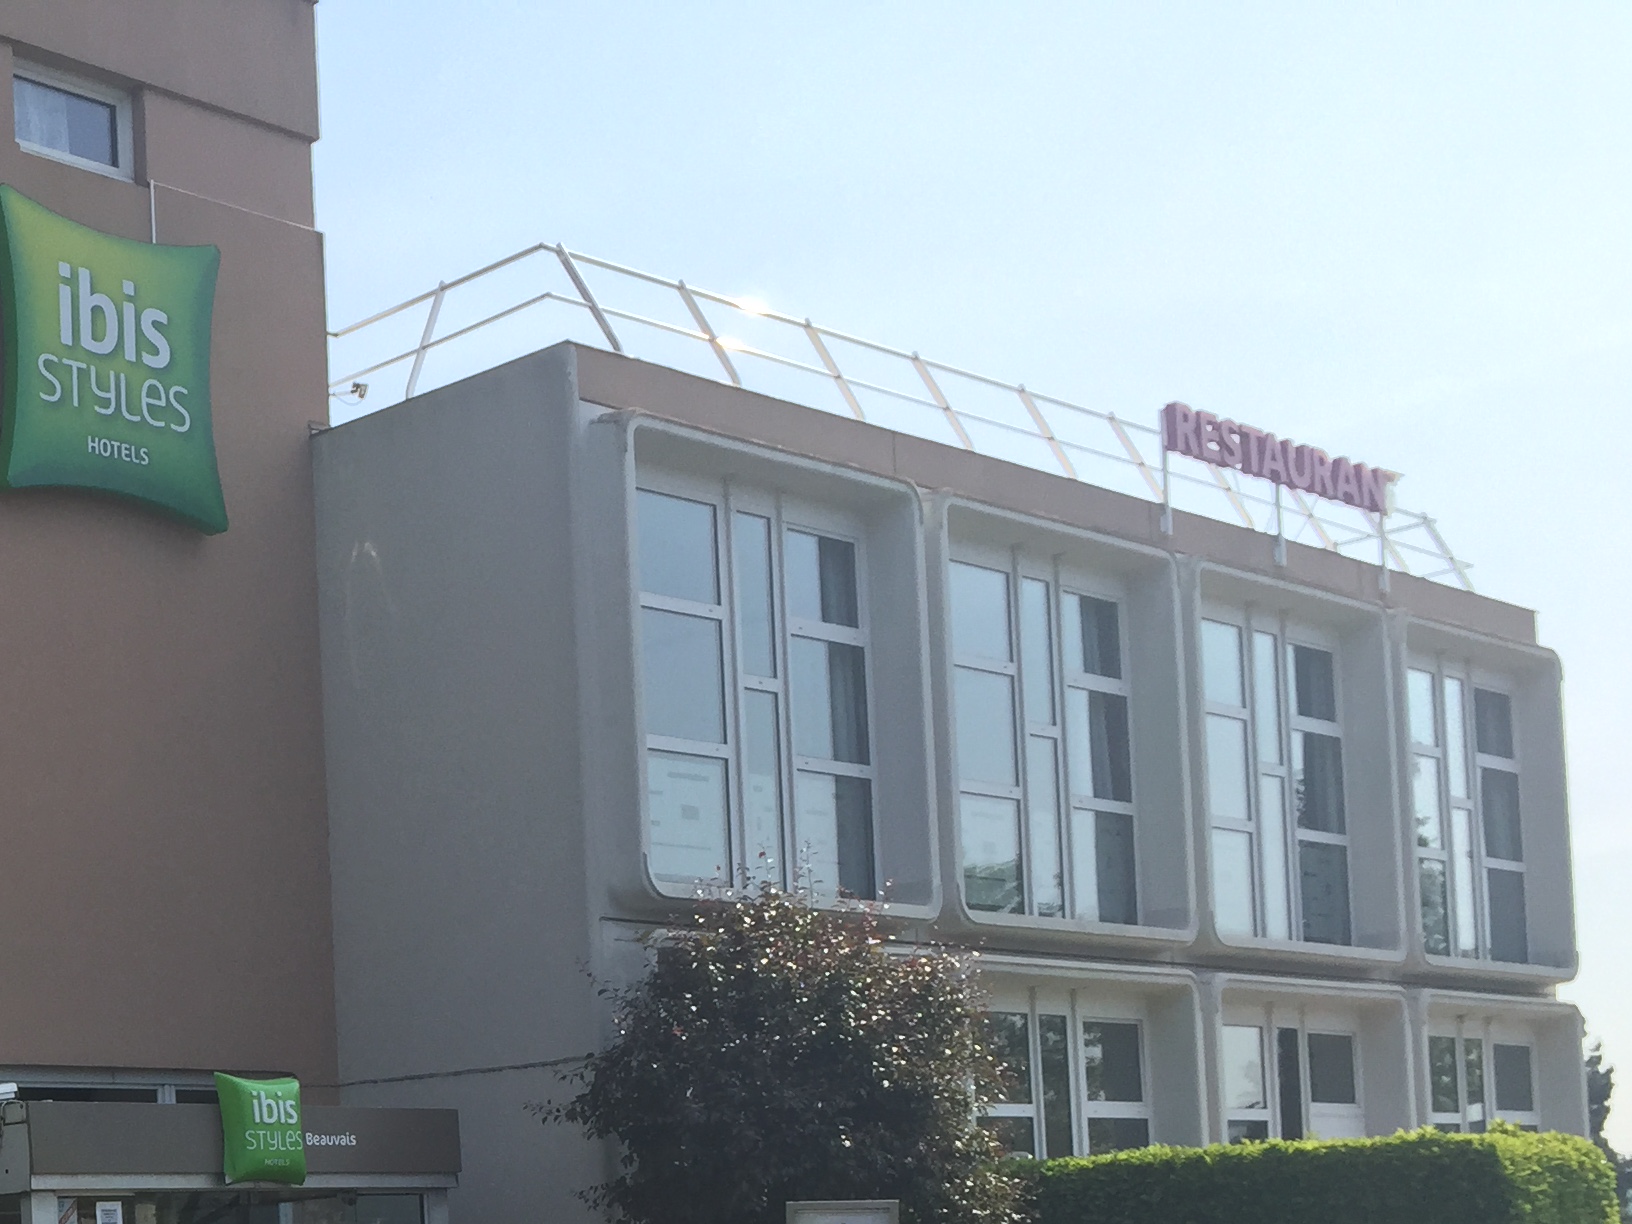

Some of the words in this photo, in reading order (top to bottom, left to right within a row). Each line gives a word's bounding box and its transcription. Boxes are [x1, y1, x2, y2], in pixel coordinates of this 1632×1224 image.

[58, 262, 170, 368] ibis
[87, 435, 149, 465] HOTELS
[251, 1090, 298, 1124] ibis
[305, 1131, 357, 1146] Beauvais
